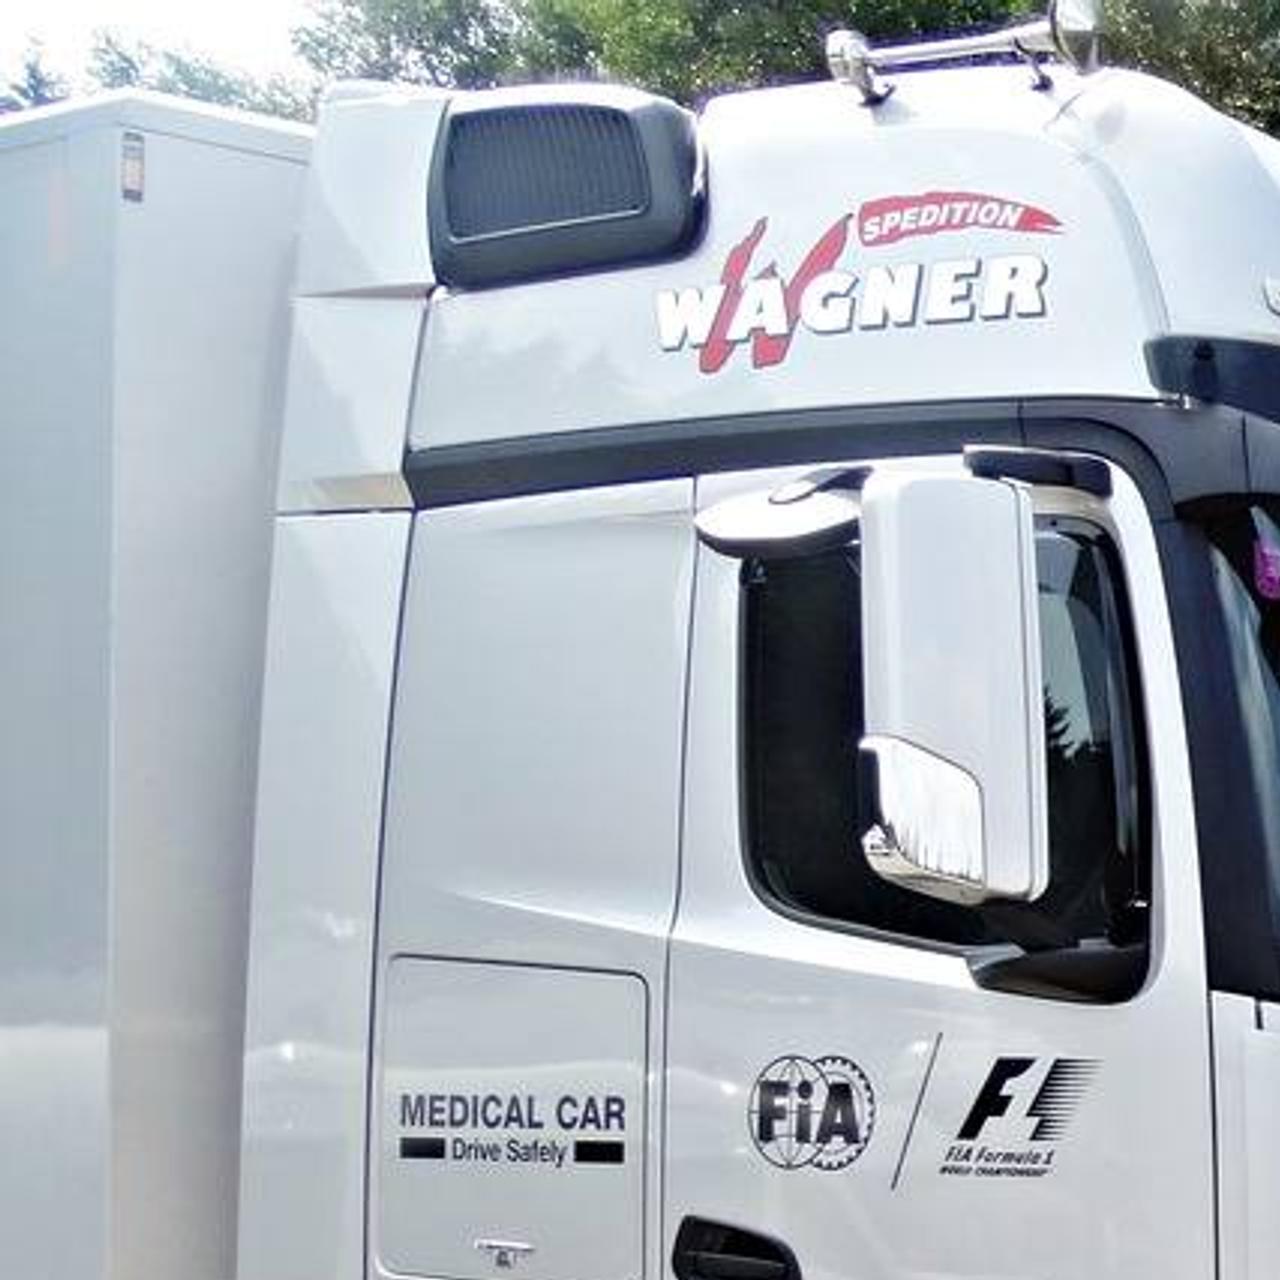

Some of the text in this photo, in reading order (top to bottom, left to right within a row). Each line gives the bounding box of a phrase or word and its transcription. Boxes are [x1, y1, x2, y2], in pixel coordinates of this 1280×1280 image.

[864, 202, 1024, 241] SPEDITION
[655, 253, 1048, 352] WAGNER
[400, 1094, 626, 1131] MEDICAL CAR
[956, 1057, 1103, 1141] F1
[451, 1137, 568, 1168] Drive Safely
[975, 1146, 1041, 1165] Formula
[1043, 1149, 1055, 1165] 1
